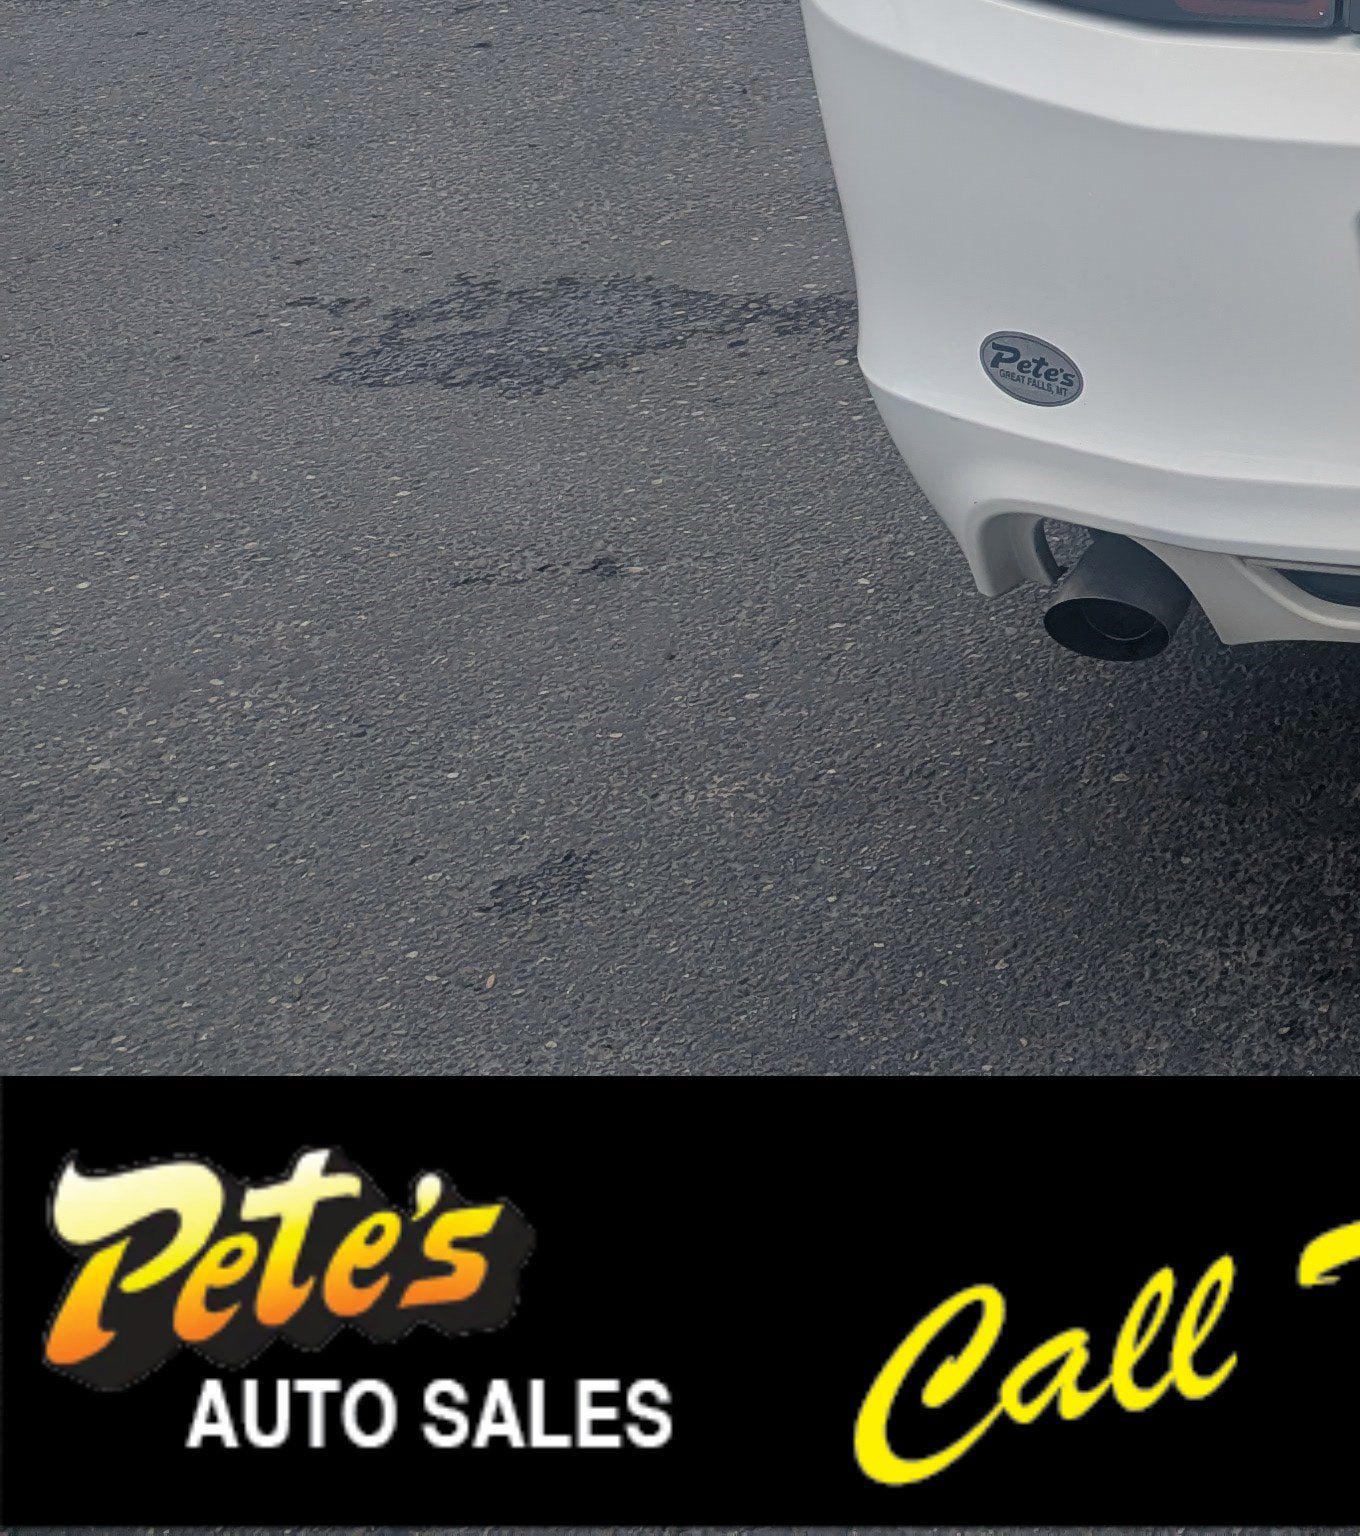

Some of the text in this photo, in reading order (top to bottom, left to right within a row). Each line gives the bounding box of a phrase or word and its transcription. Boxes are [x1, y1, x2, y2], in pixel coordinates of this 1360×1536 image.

[990, 341, 1076, 387] Pete's
[1000, 368, 1026, 385] GREAT
[1026, 377, 1055, 395] FALLS,
